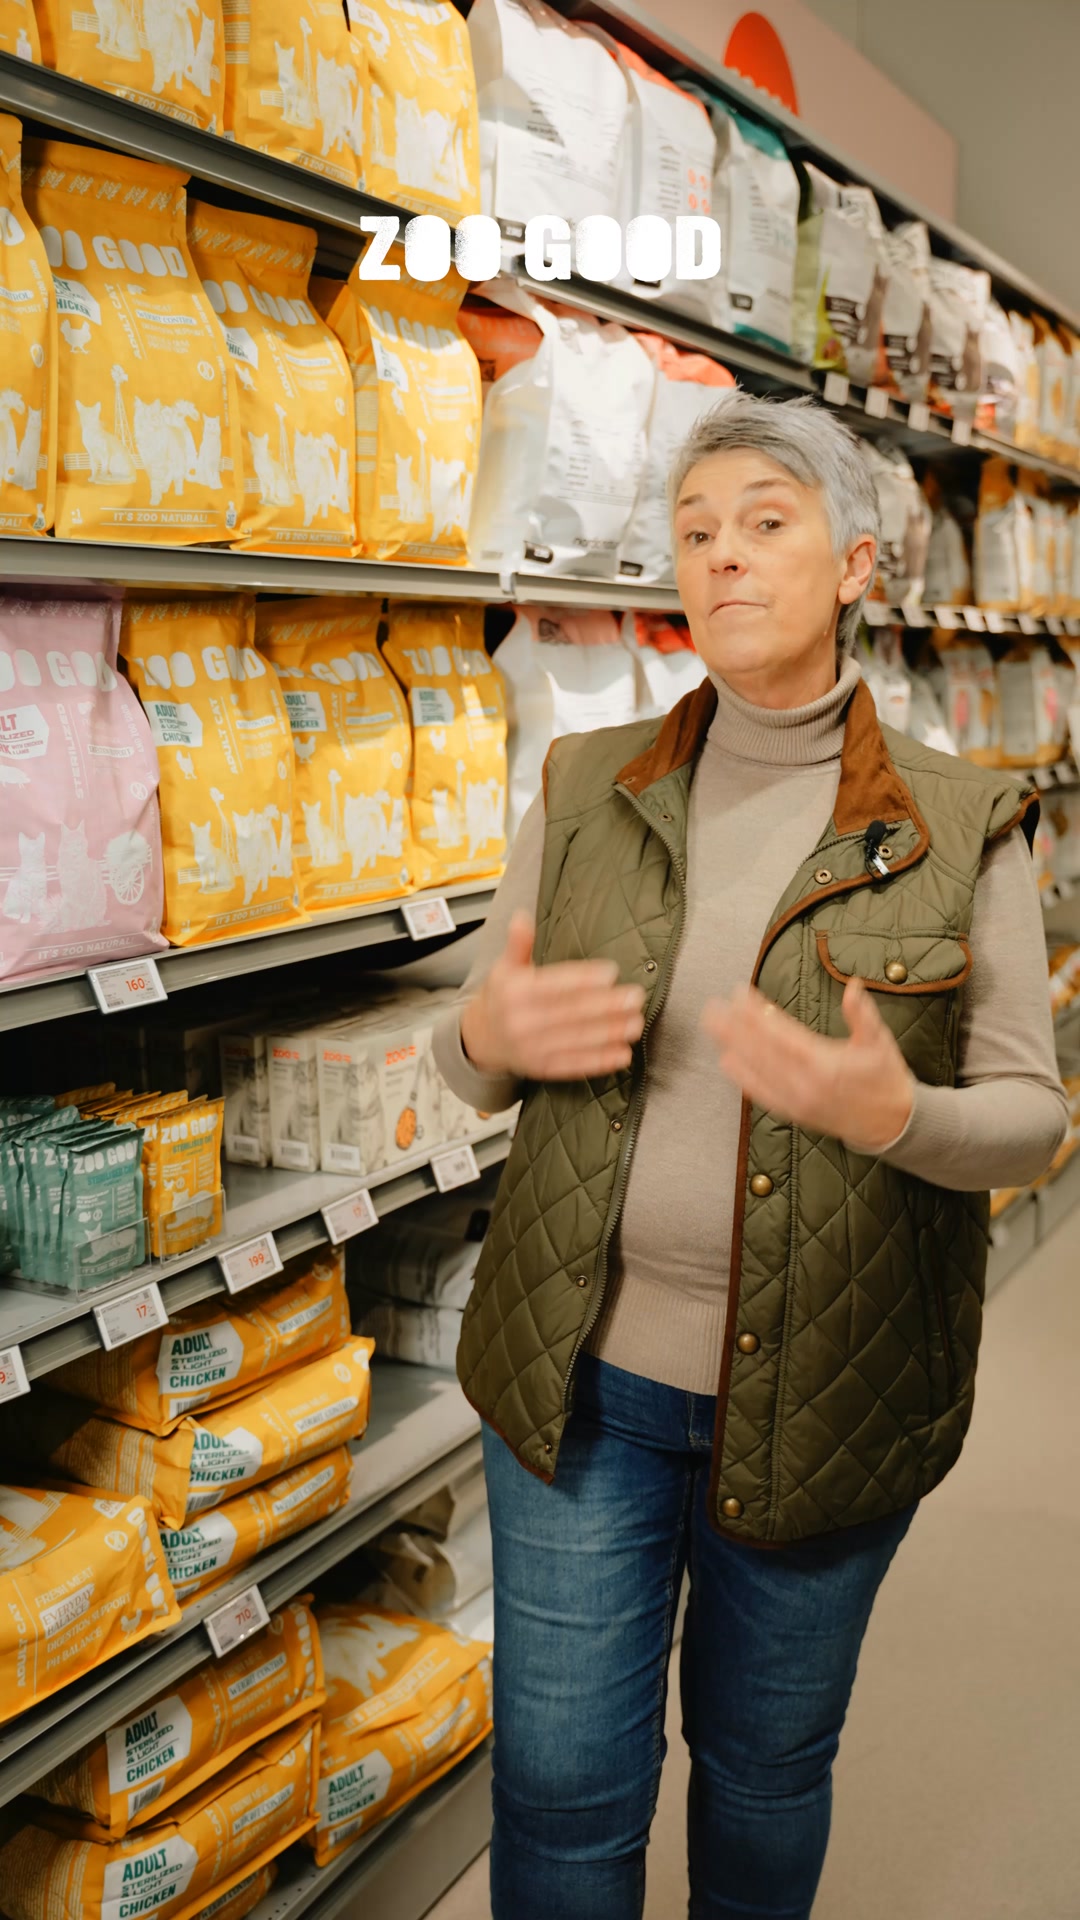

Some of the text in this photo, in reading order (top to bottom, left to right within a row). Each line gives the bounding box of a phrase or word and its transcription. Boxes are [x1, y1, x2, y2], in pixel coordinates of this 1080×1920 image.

[41, 226, 188, 278] OO GOOD
[56, 298, 91, 317] HICKEN
[202, 279, 248, 314] OO
[113, 511, 208, 523] IT'S ZOO NATURAL!
[0, 649, 42, 692] OO
[155, 704, 177, 718] ADULT
[290, 719, 319, 729] HICKEN
[232, 911, 248, 922] ZOO
[38, 937, 135, 961] IT'S ZOO NATURAL!
[160, 1122, 189, 1145] ZOO
[73, 1151, 105, 1175] ZOO
[171, 1332, 213, 1356] ADULT
[171, 1348, 228, 1365] STERILIZED
[182, 1359, 214, 1370] LIGHT
[169, 1367, 227, 1389] CHICKEN
[194, 1432, 232, 1451] ADUL
[201, 1458, 232, 1468] LIGHT
[168, 1556, 217, 1580] HICKEN
[34, 1566, 95, 1608] FRESH MEAT
[42, 1586, 94, 1625] EVERYDAY
[47, 1603, 88, 1636] BALANCE
[47, 1592, 131, 1654] DIGESTION SUPPORT
[8, 1602, 28, 1688] ADULT CAT
[62, 1626, 104, 1660] BALANCE
[125, 1710, 158, 1748] ADULT
[127, 1724, 175, 1757] STERILIZED
[137, 1741, 160, 1760] LIGHT
[127, 1745, 176, 1783] CHICKEN
[329, 1764, 365, 1795] ADULT
[122, 1848, 167, 1883] ADULT
[122, 1863, 184, 1893] STERILIZED
[132, 1879, 163, 1896] LIGHT
[119, 1883, 177, 1919] CHICKEN
